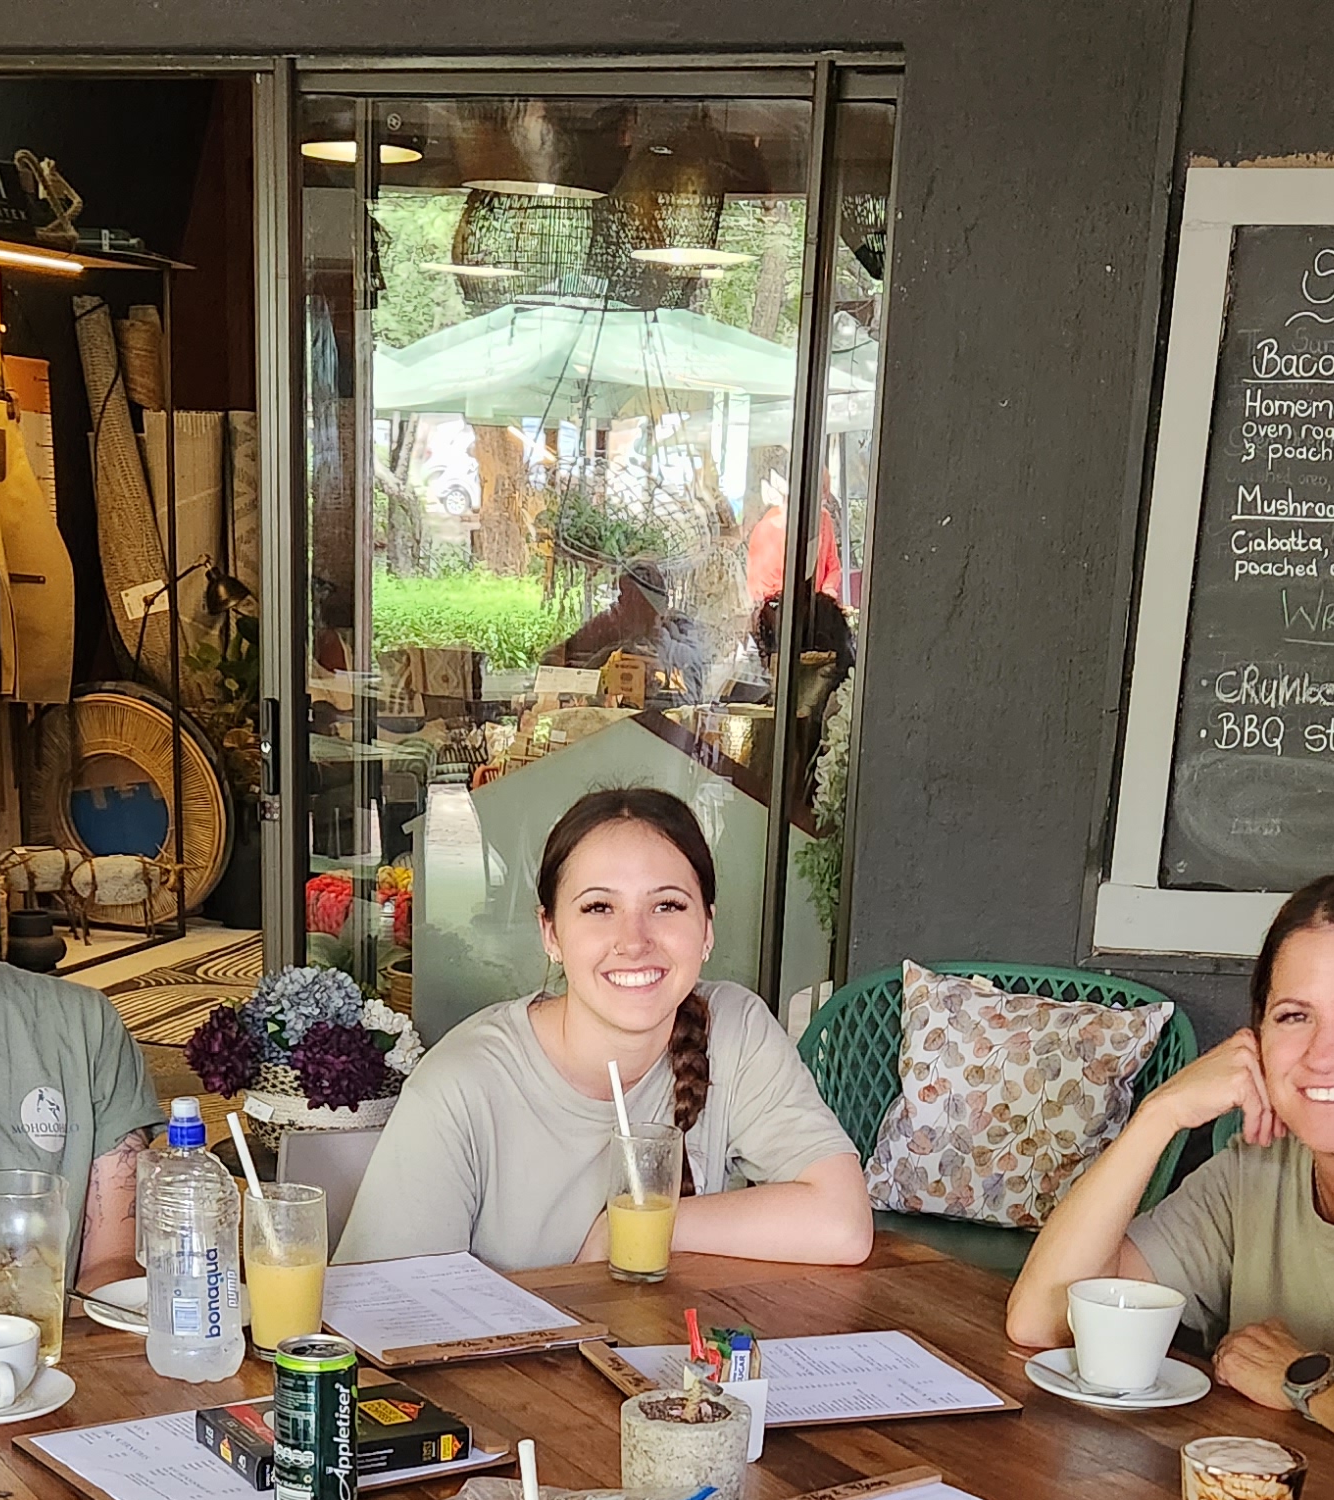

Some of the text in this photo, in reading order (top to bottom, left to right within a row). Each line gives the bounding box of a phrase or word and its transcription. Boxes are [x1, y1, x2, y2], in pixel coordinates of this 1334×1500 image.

[1241, 420, 1292, 439] oven
[1231, 527, 1329, 557] Ciabatta,
[1234, 557, 1319, 582] poached
[1214, 712, 1284, 756] BBQ
[205, 1248, 223, 1339] bonaqua
[227, 1269, 239, 1309] pump
